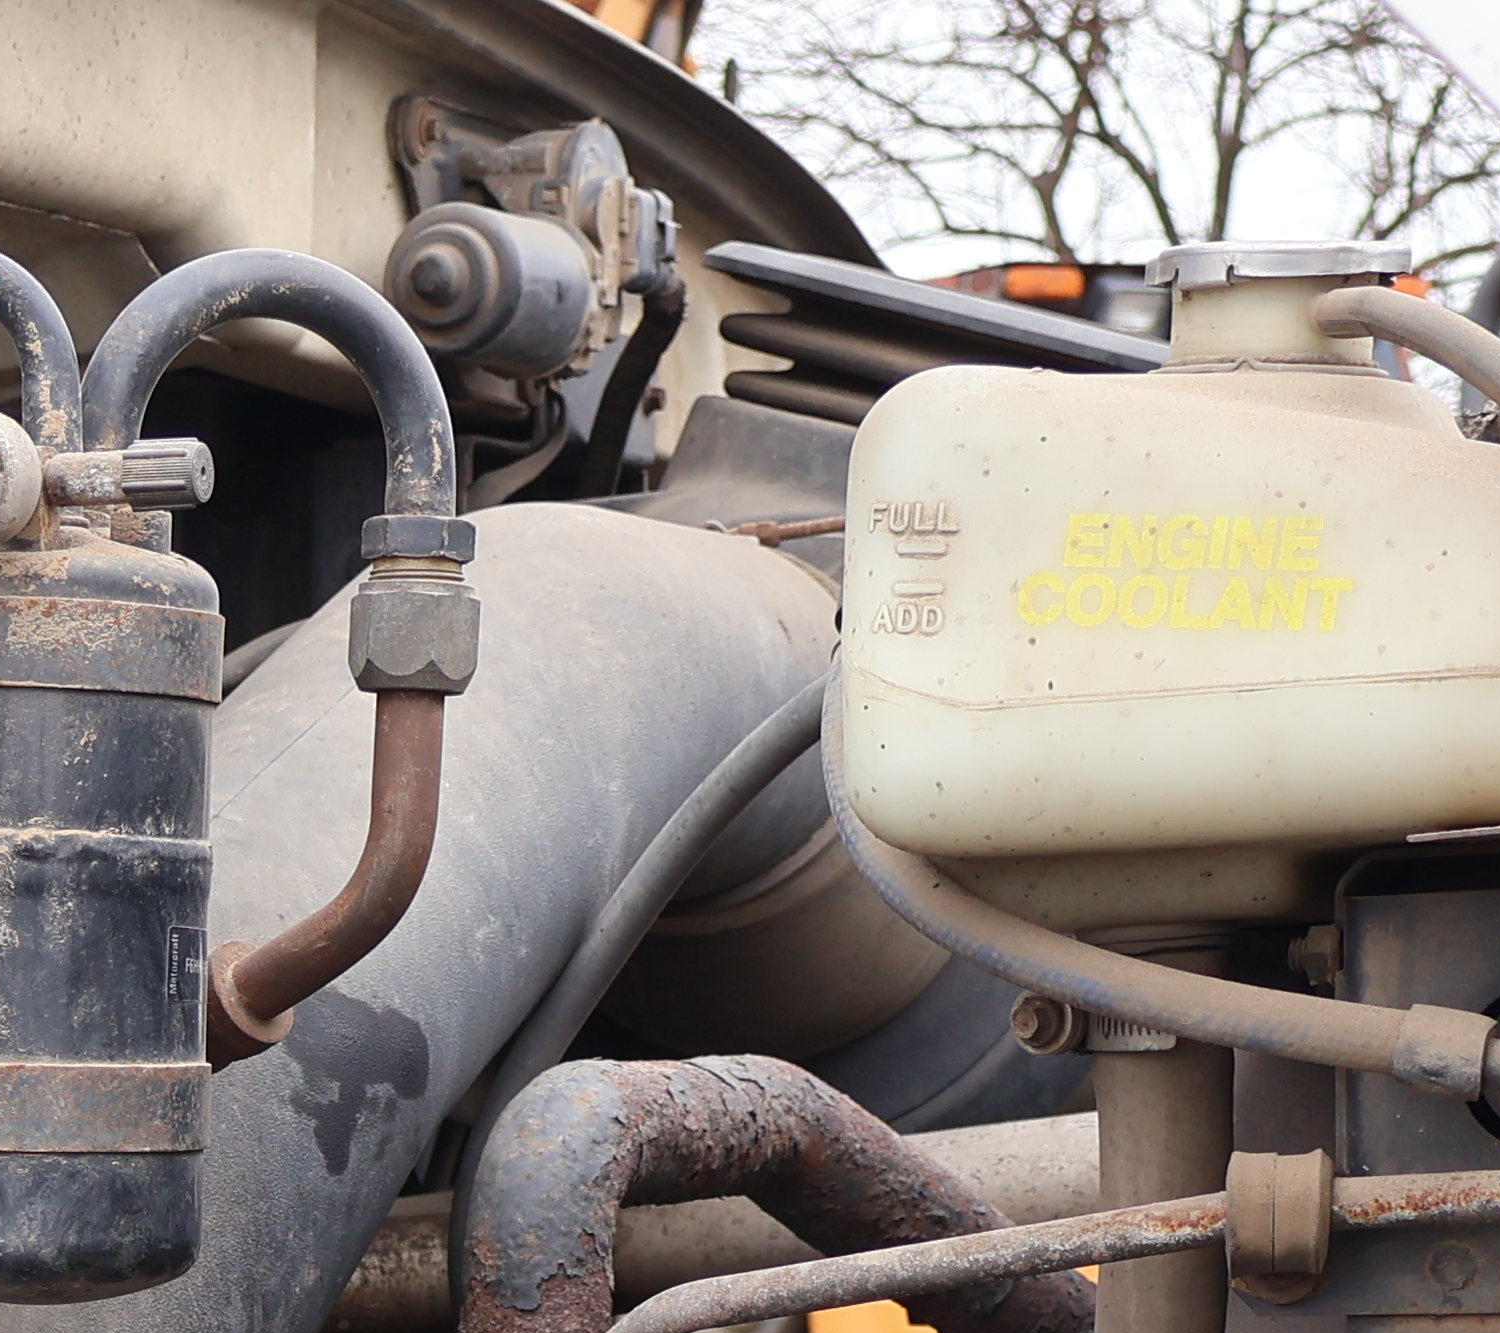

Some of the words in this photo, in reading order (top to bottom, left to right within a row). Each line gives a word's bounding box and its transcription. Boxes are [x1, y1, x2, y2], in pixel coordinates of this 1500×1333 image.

[868, 502, 960, 535] FULL
[1061, 513, 1325, 571] ENGINE
[872, 603, 945, 634] ADD
[1016, 573, 1355, 631] COOLANT
[169, 934, 180, 994] Motorcraft
